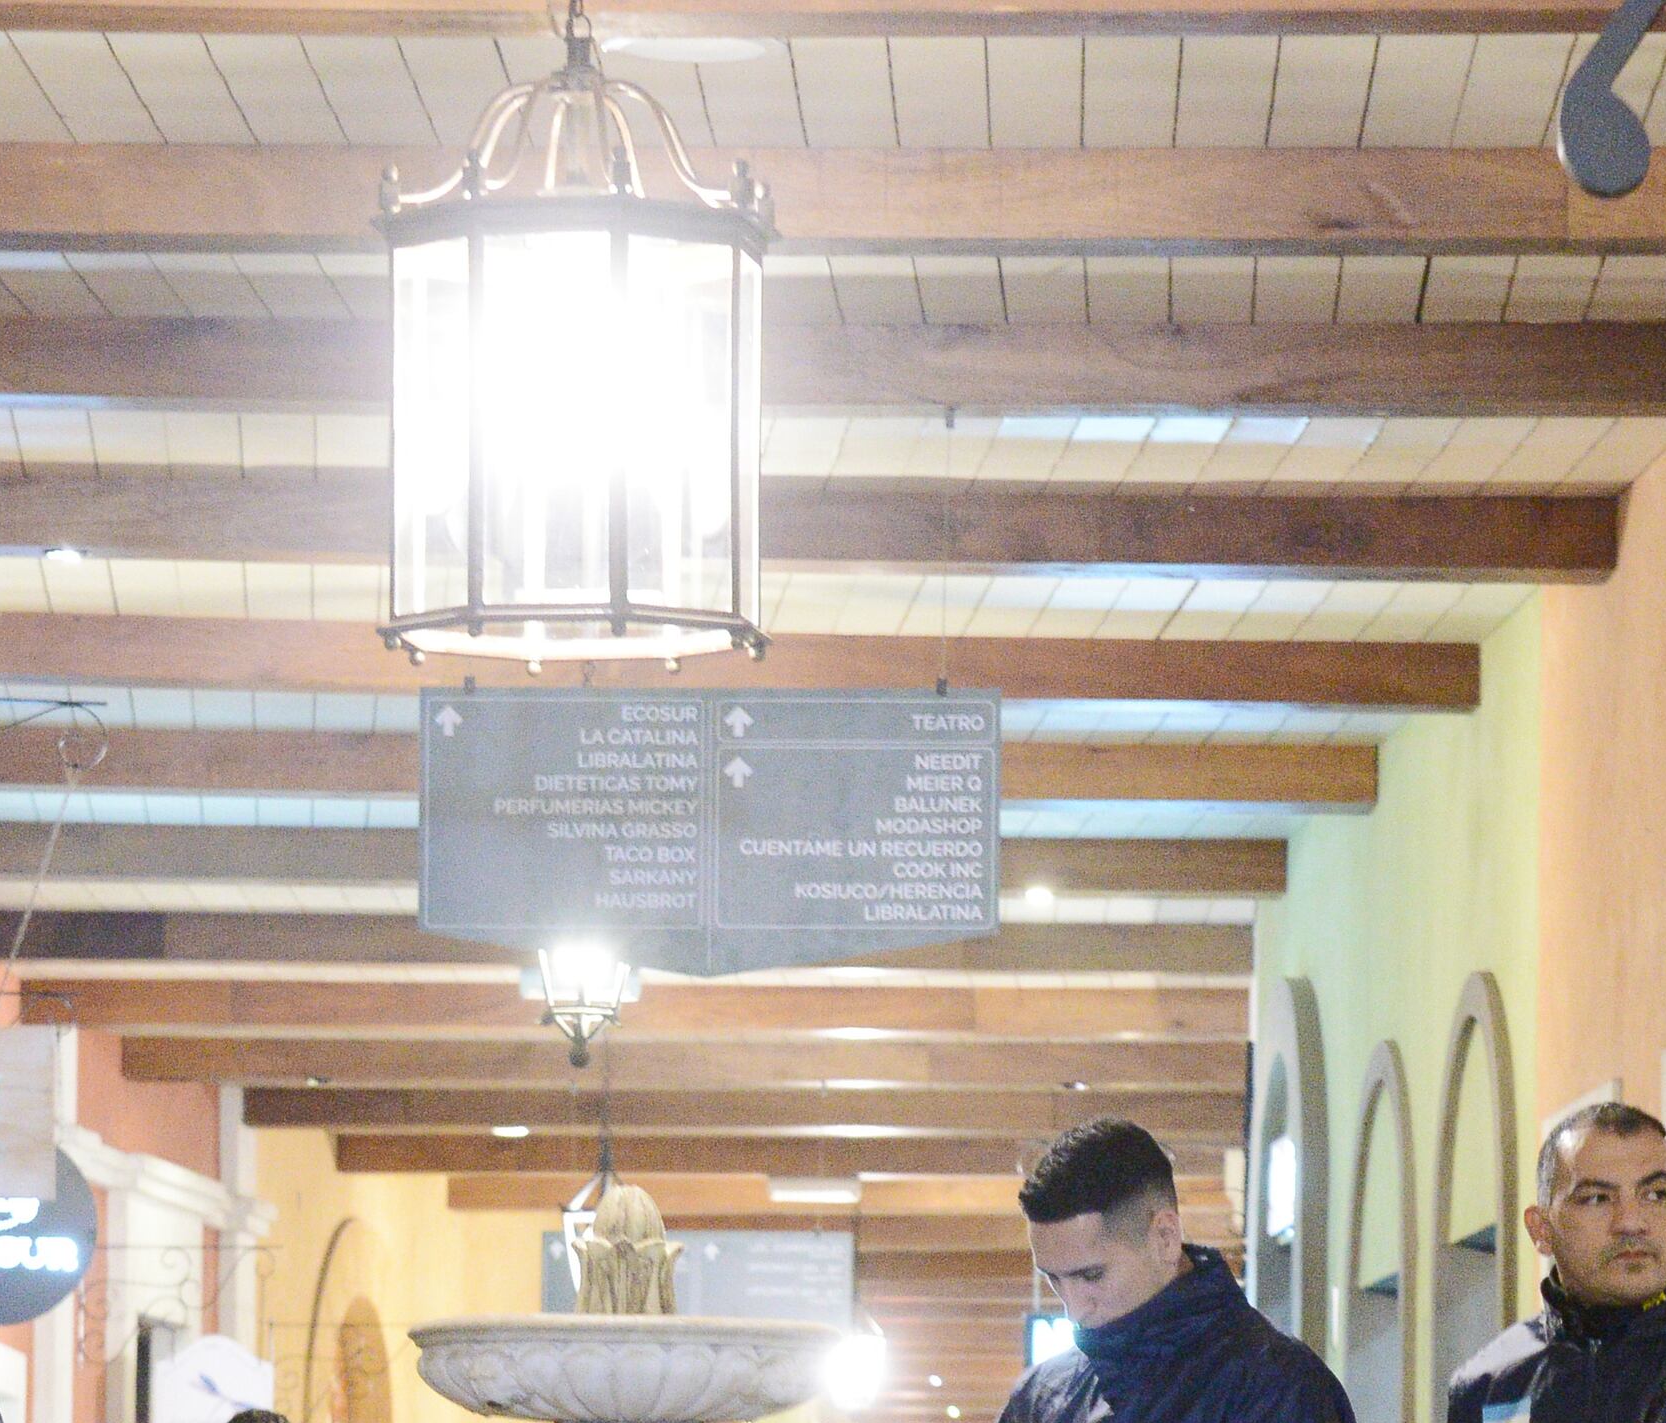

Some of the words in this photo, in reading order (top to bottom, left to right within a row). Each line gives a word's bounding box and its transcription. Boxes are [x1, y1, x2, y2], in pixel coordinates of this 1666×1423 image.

[621, 704, 698, 722] ECOSUR
[912, 713, 985, 732] TEATRO
[580, 728, 604, 745] LA
[607, 728, 698, 745] CATALINA
[577, 751, 698, 768] LIBRALATINA
[914, 753, 984, 771] NEEDIT
[534, 774, 641, 792] DIETETICAS
[645, 775, 698, 792] TOMY
[906, 774, 964, 792] MEIER
[493, 798, 623, 816] PERFUMERIAS
[628, 798, 699, 816] MICKEY
[894, 796, 983, 813] BALUNEK
[547, 821, 618, 839] SILVINA
[621, 822, 698, 839] GRASSO
[874, 817, 983, 835] MODASHOP
[604, 845, 653, 862] TACO
[657, 845, 697, 863] BOX
[739, 838, 844, 857] CUENTAME
[847, 840, 877, 857] UN
[880, 840, 984, 858] RECUERDO
[608, 868, 697, 886] SARKANY
[892, 861, 948, 879] COOK
[951, 862, 984, 879] INC
[793, 881, 984, 900] KOSIUCO/HERENCIA
[594, 892, 696, 909] HAUSBROT
[863, 903, 984, 921] LIBRALATINA
